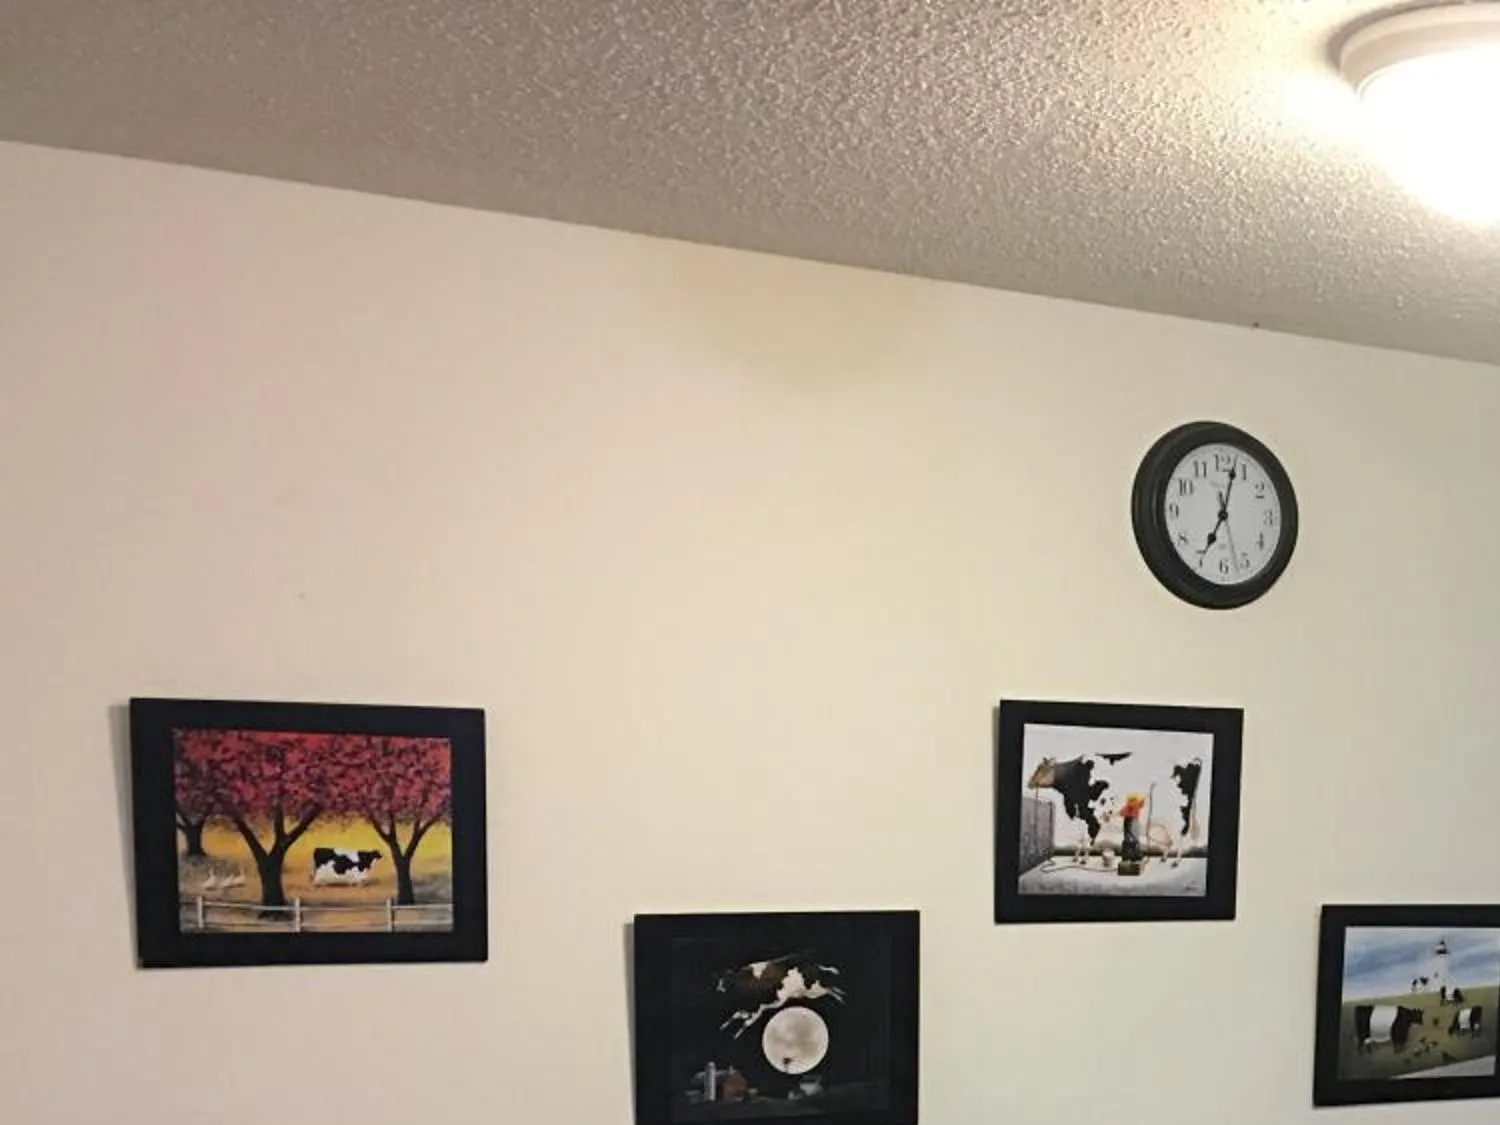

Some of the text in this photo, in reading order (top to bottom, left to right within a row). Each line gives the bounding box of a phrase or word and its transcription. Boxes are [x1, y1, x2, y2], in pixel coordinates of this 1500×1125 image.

[1193, 460, 1208, 479] 11
[1214, 454, 1231, 473] 12
[1240, 463, 1247, 481] 1
[1178, 478, 1194, 496] 10
[1254, 481, 1265, 499] 2
[1169, 503, 1180, 520] 9
[1256, 532, 1264, 550] 4
[1219, 558, 1229, 575] 6
[1240, 552, 1250, 569] 5
